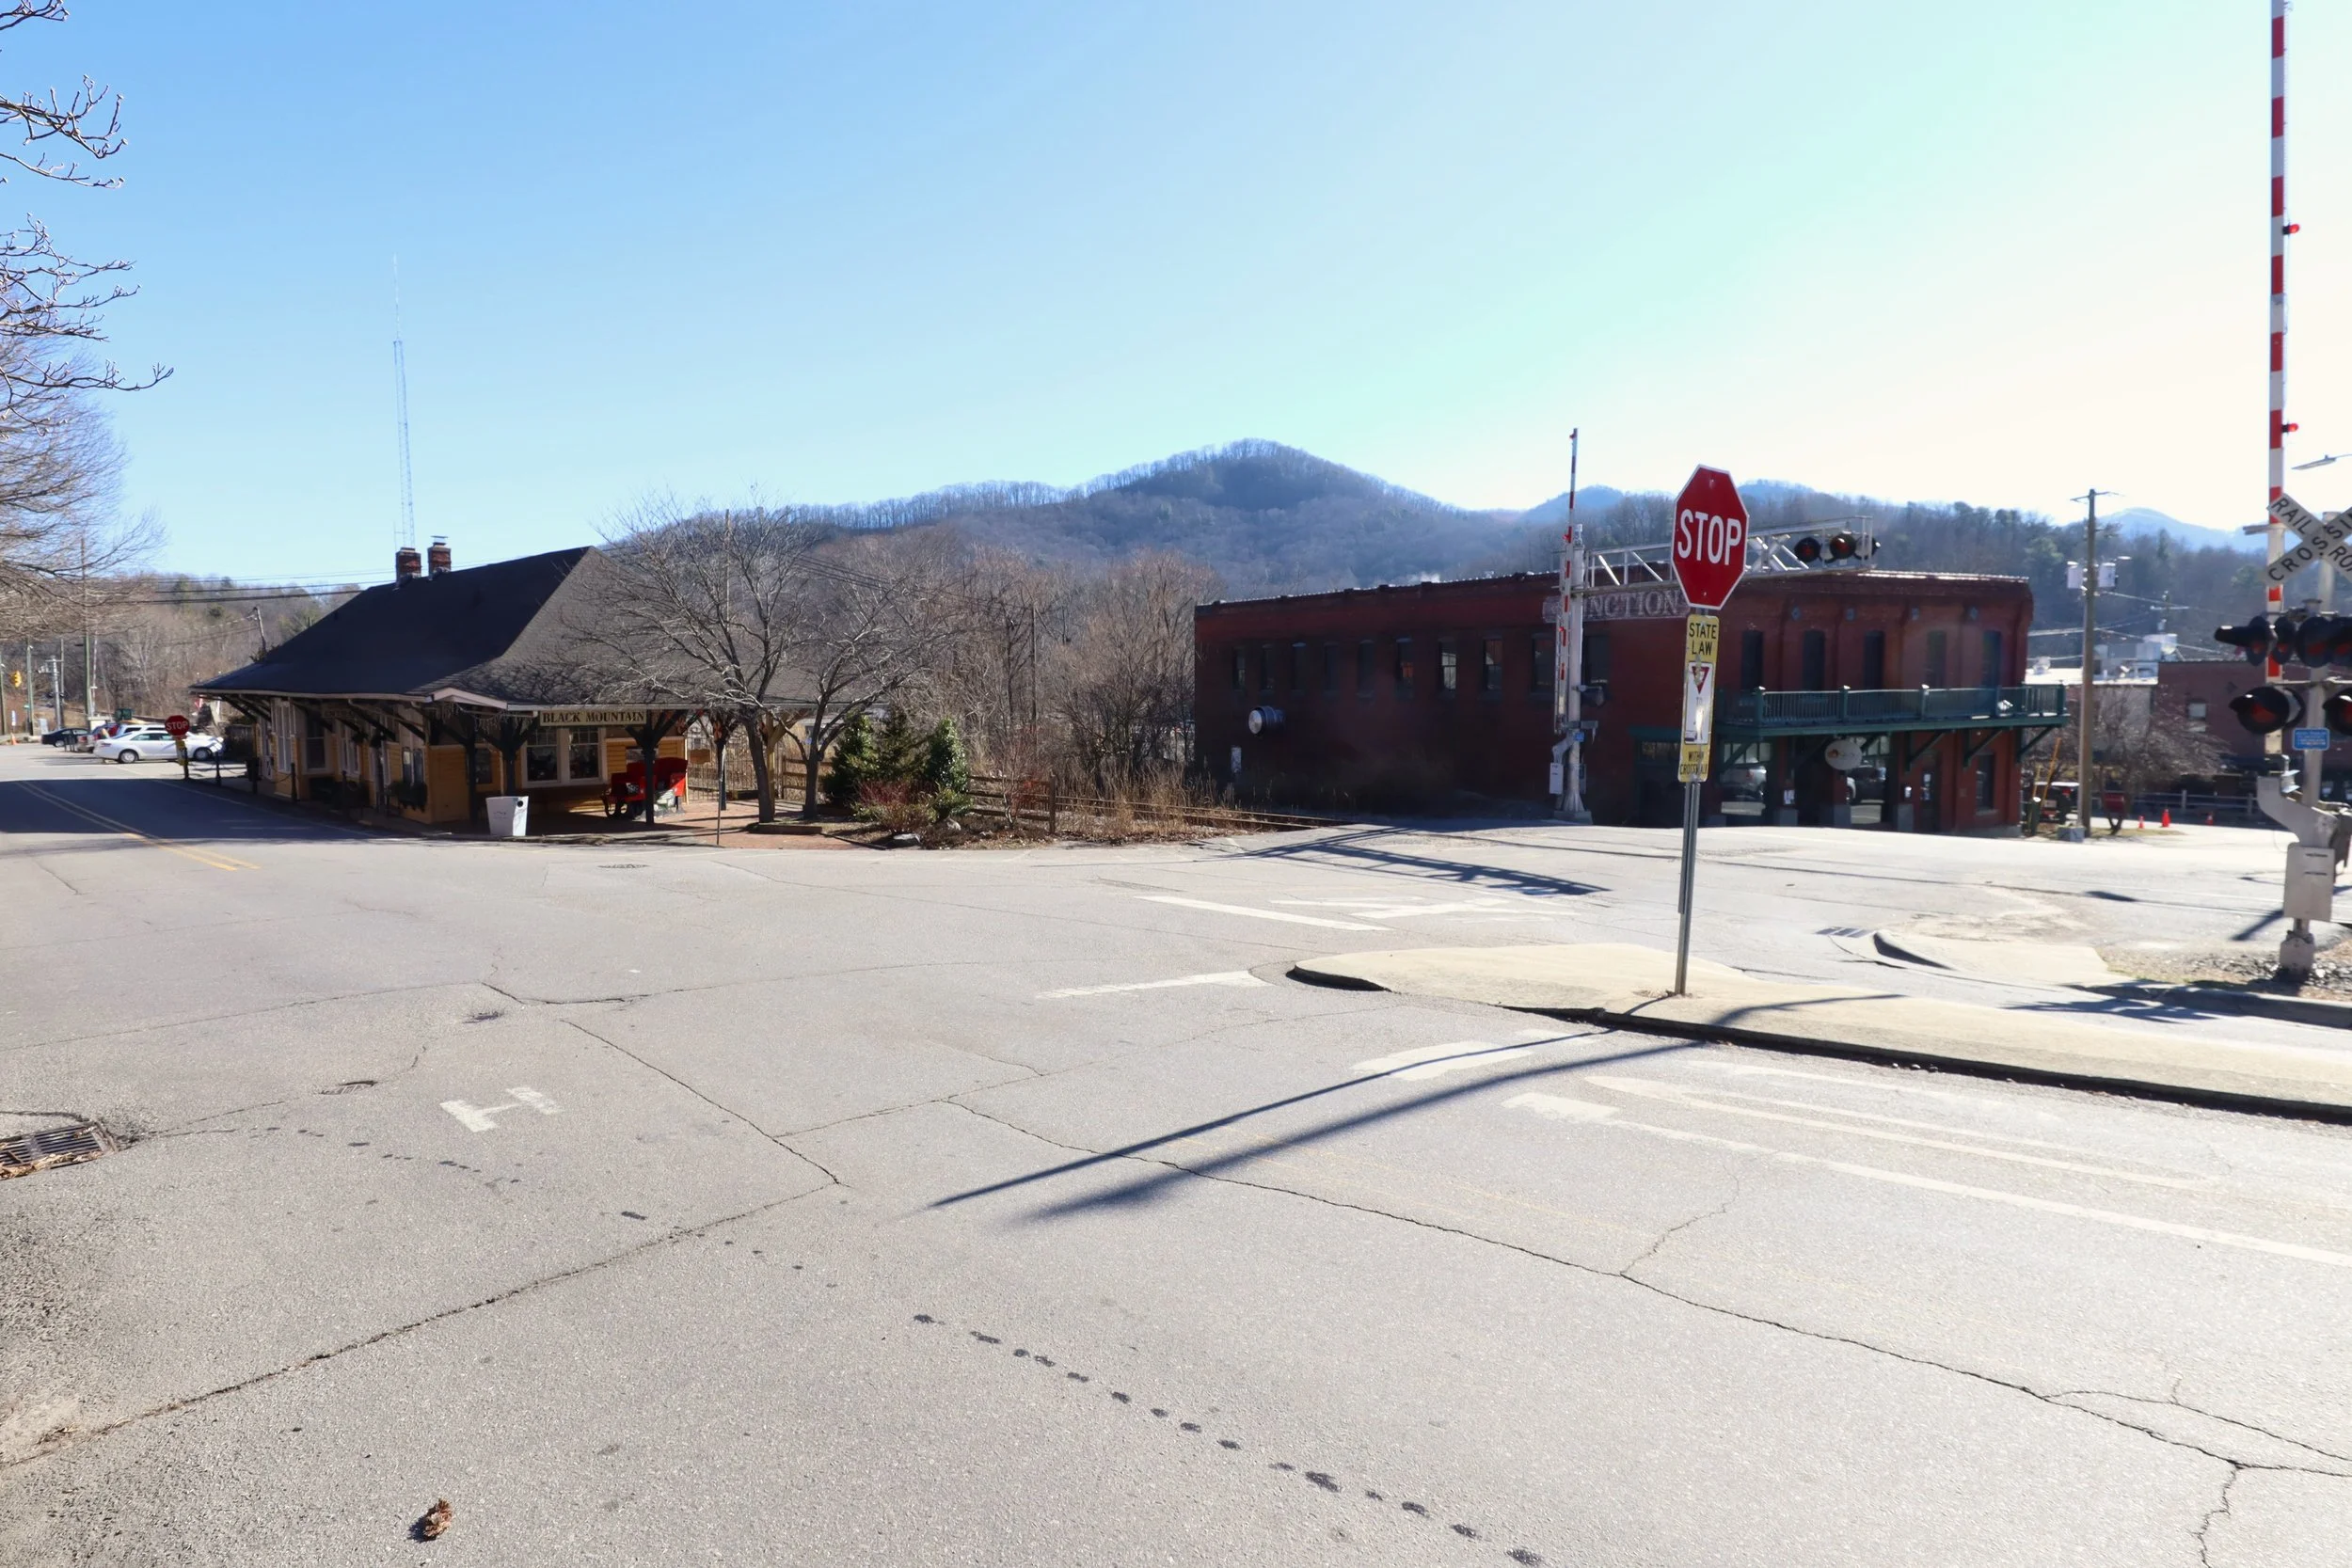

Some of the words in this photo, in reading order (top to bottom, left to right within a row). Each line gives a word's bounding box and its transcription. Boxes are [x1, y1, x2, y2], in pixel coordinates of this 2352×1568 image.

[2271, 498, 2312, 534] RAIL
[1677, 509, 1742, 565] STOP
[2268, 513, 2352, 581] CROSSI
[1689, 623, 1717, 640] STATE
[1692, 640, 1712, 656] LAW
[543, 712, 580, 723] BLACK
[585, 711, 644, 722] MOUNTAIN
[167, 721, 188, 731] STOP
